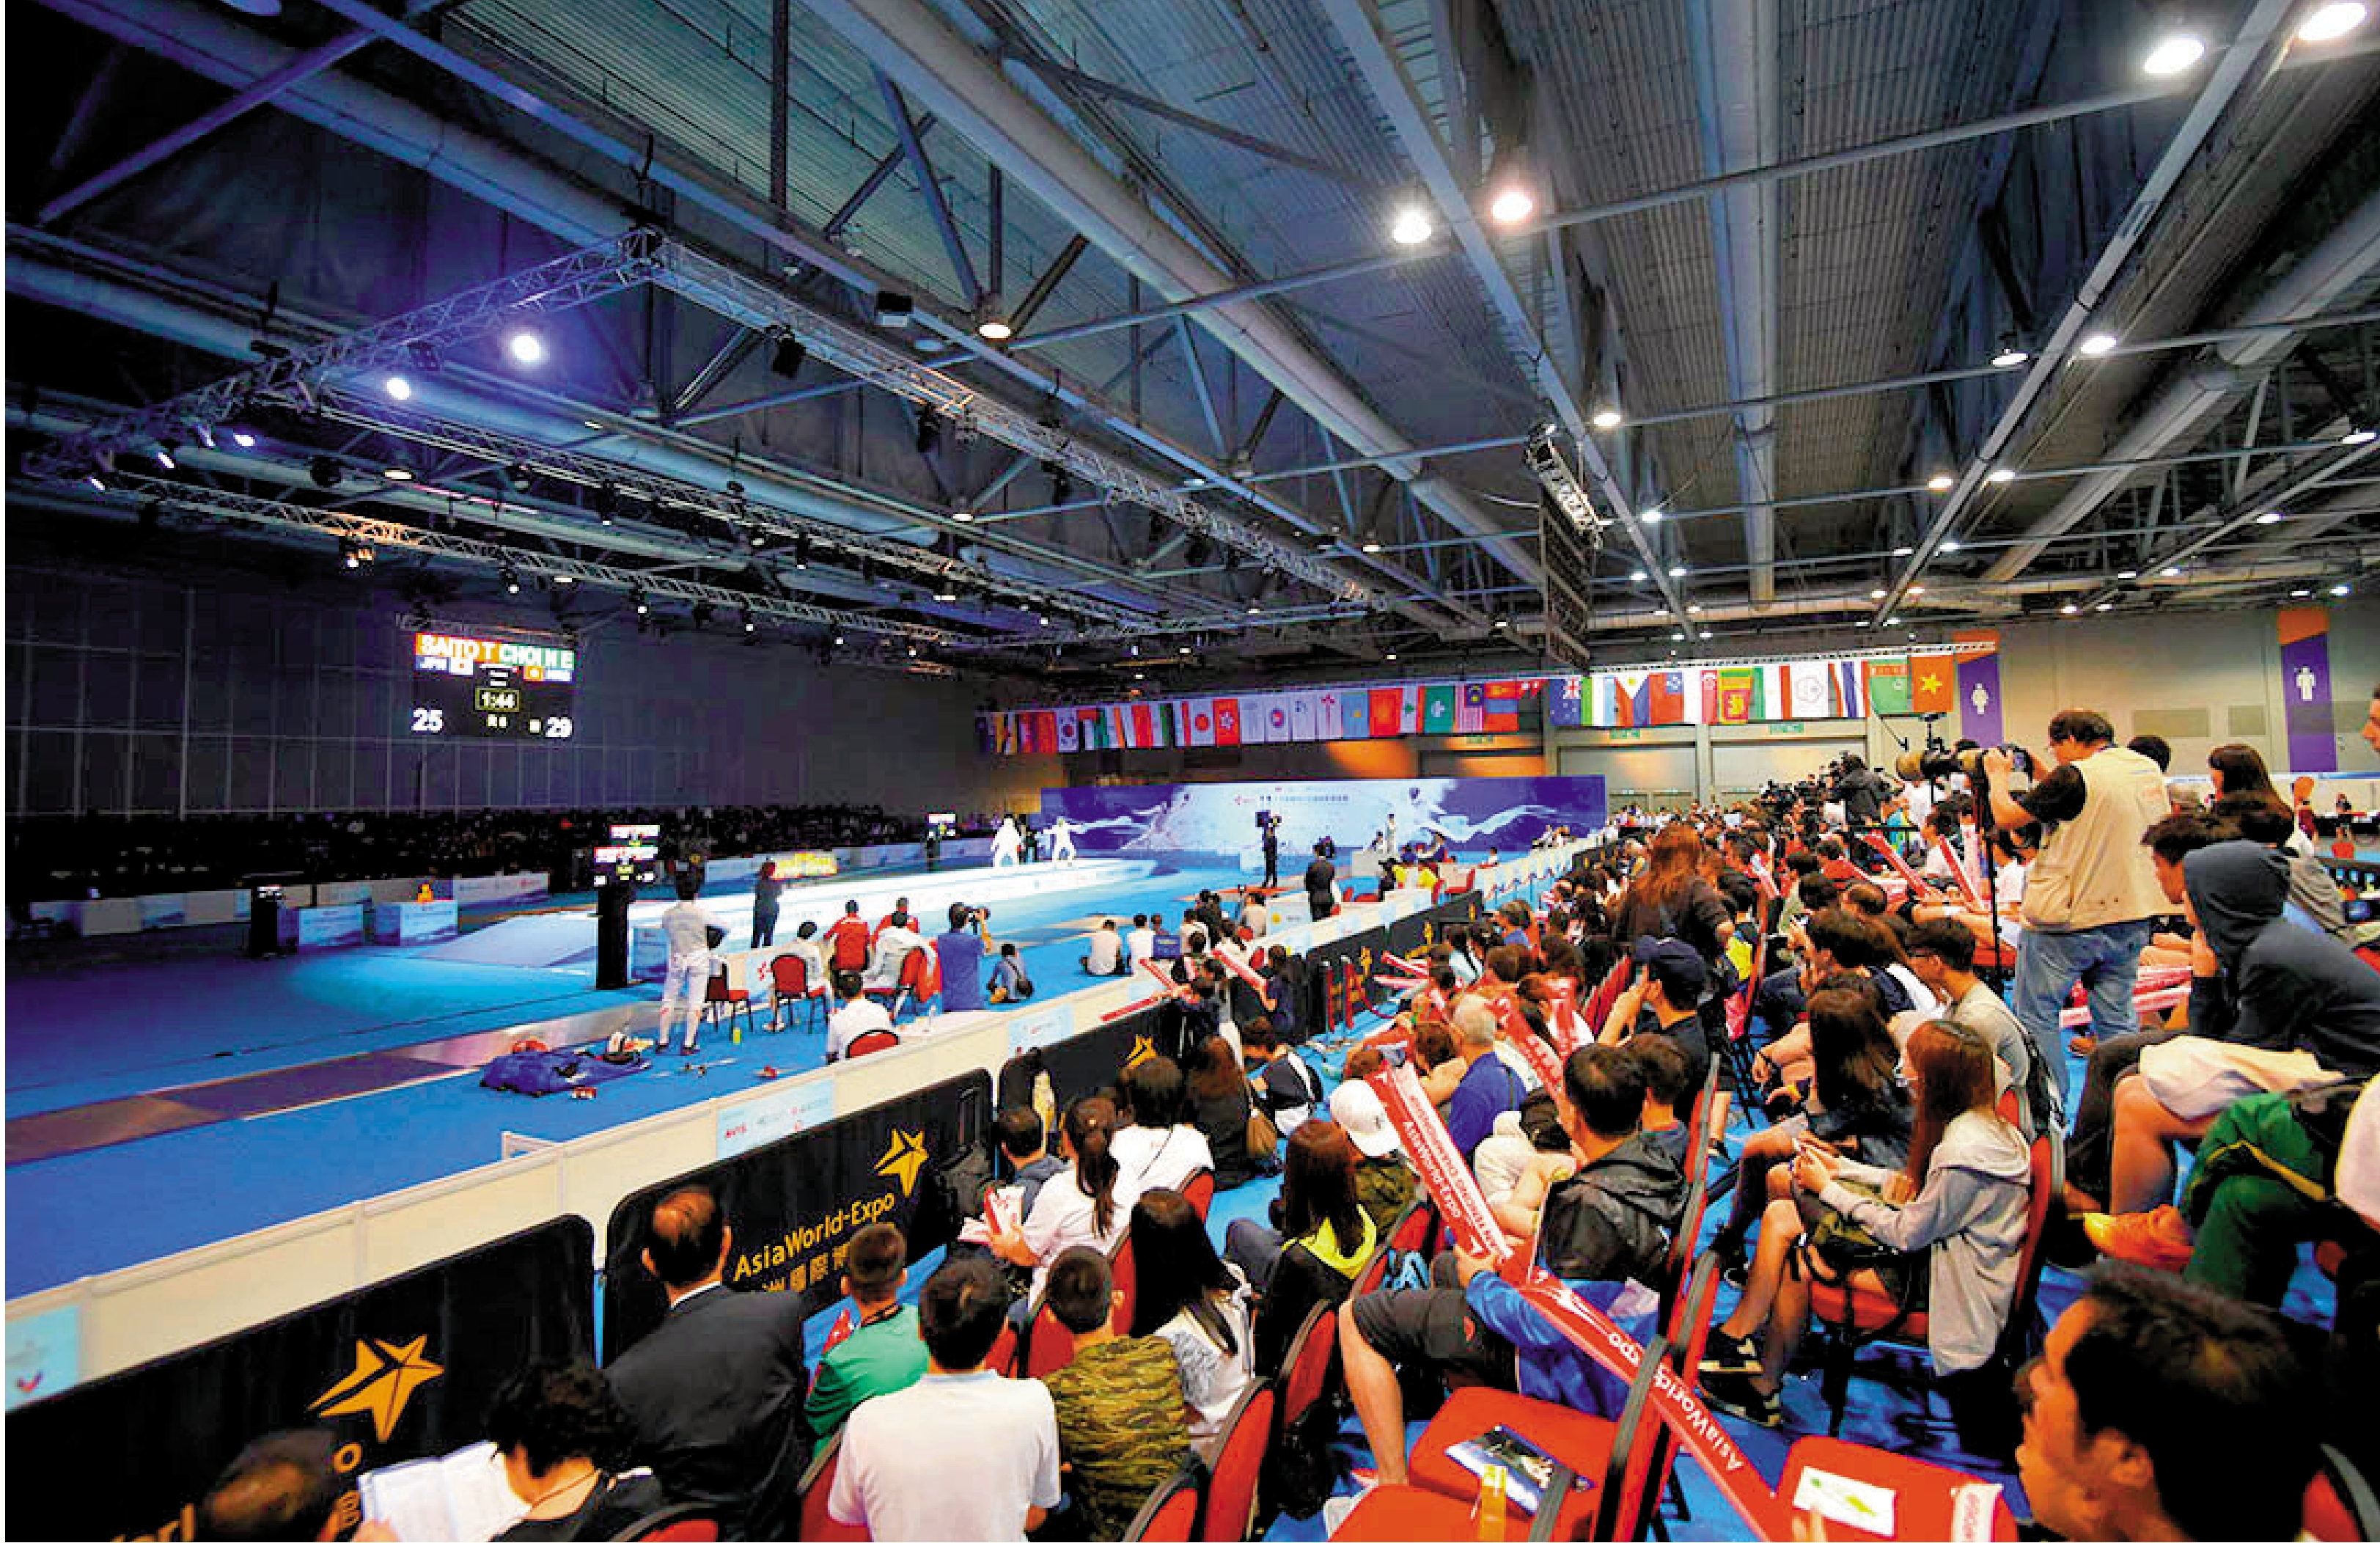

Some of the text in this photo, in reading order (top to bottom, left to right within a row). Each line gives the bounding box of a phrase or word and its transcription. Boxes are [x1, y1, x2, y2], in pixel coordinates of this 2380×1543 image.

[422, 634, 496, 660] SAITO T
[561, 650, 573, 669] E
[411, 708, 443, 733] 25
[546, 716, 573, 738] 29
[1403, 1121, 1461, 1219] AsiaWorld-Expo
[733, 1192, 895, 1282] AsiaWorld-Expo
